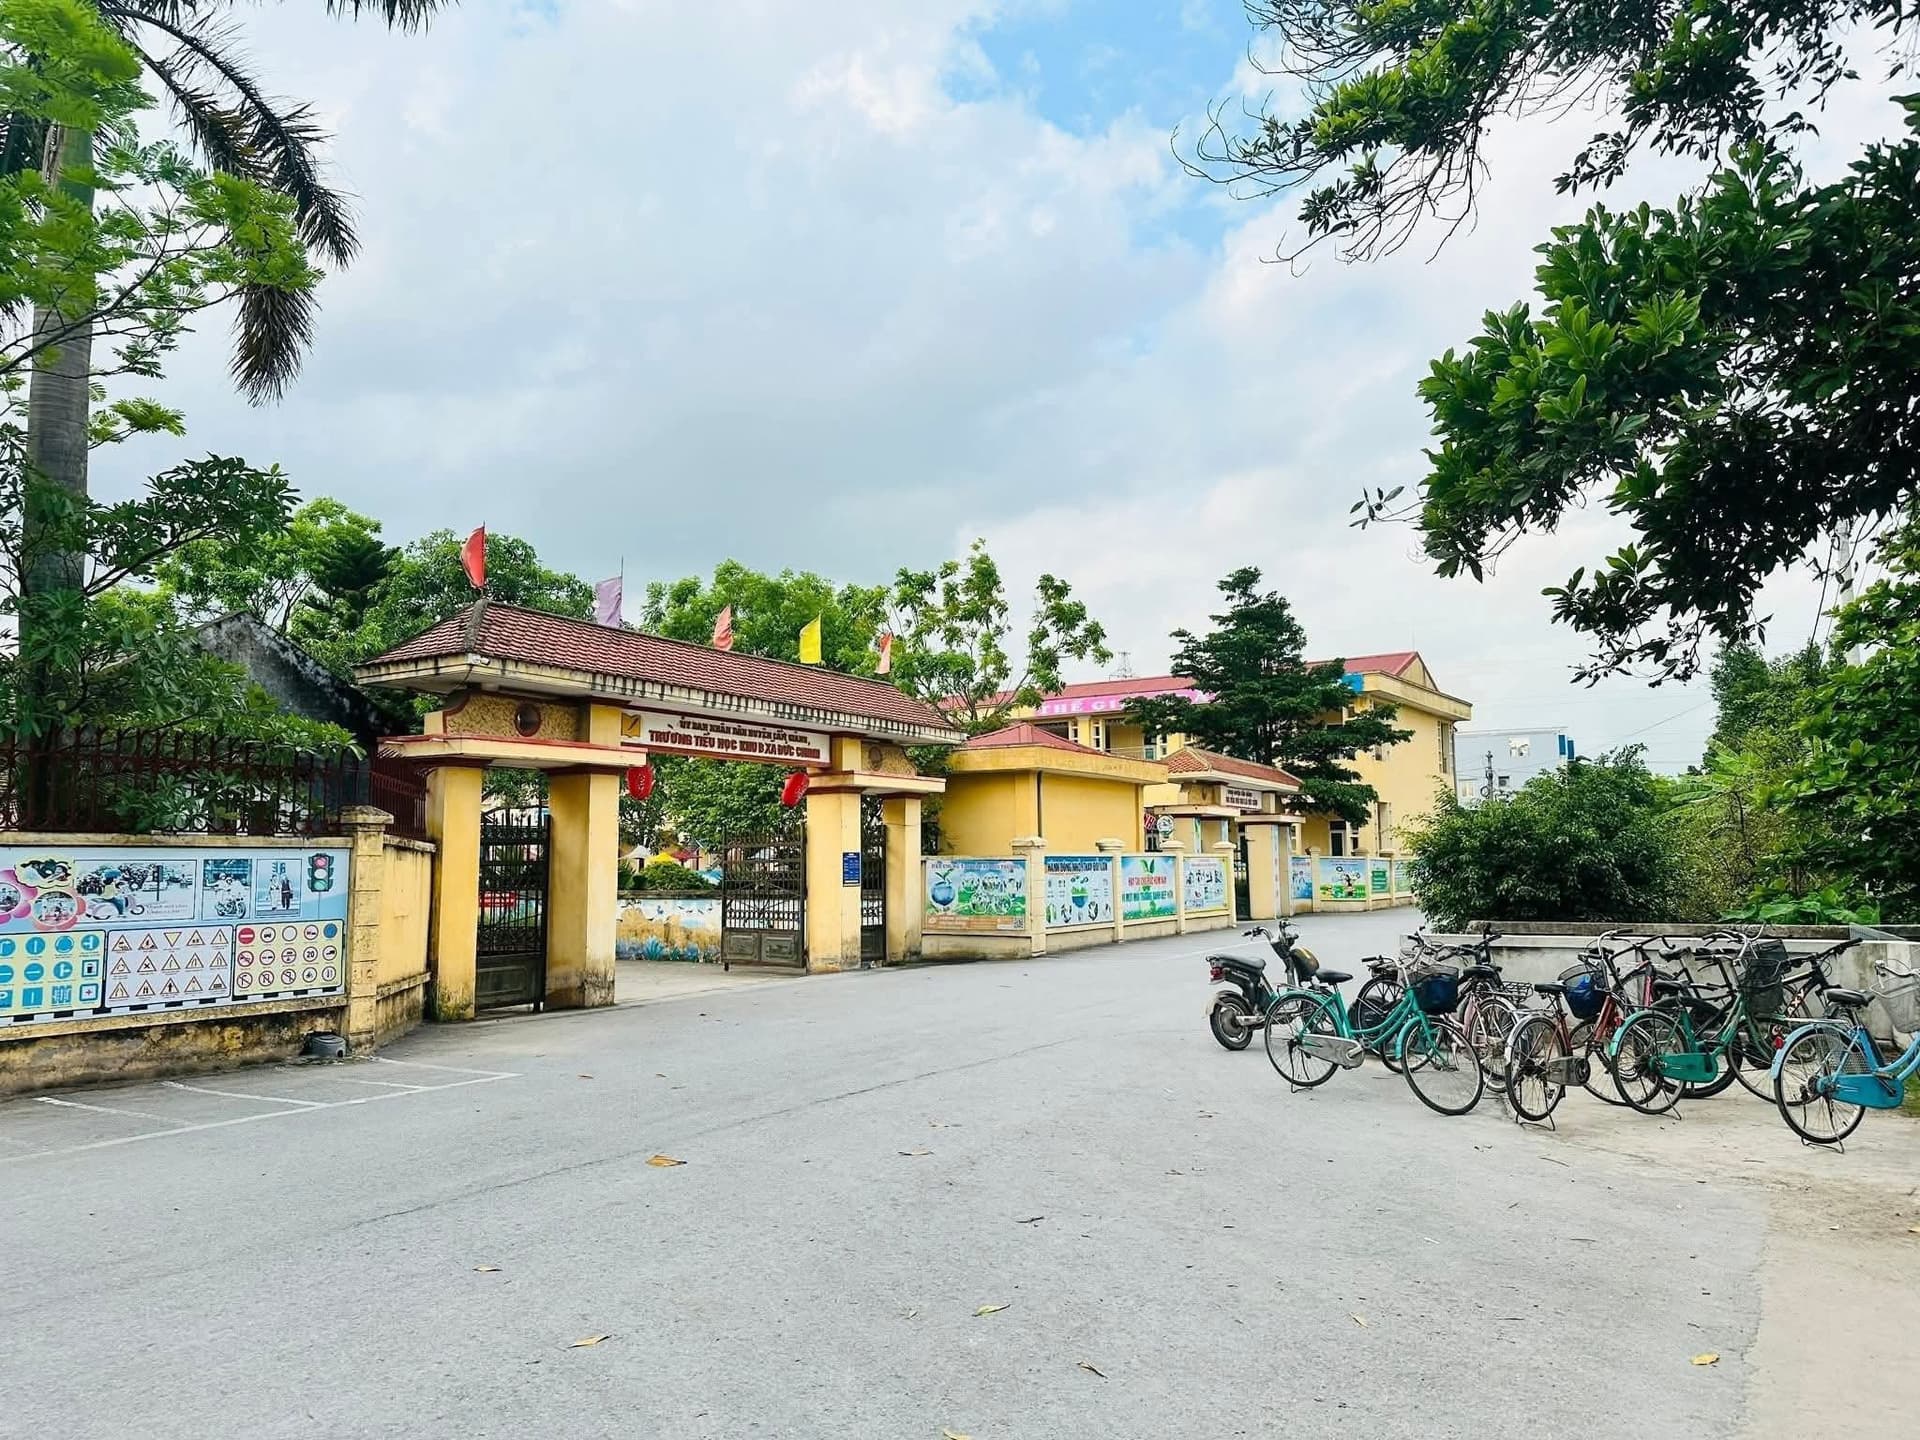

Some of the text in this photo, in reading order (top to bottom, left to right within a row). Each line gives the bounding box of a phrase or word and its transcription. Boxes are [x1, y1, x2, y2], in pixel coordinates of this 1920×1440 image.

[1041, 699, 1083, 716] THẾ
[679, 716, 691, 729] ỦY
[692, 721, 708, 732] BAN
[709, 722, 731, 734] NHÂN
[732, 725, 747, 737] DÂN
[648, 723, 692, 745] TRƯỜNG
[694, 732, 715, 748] TIỂU
[717, 738, 737, 751] HỌC
[739, 740, 758, 753] KHU
[758, 742, 765, 753] B
[306, 950, 315, 958] 20
